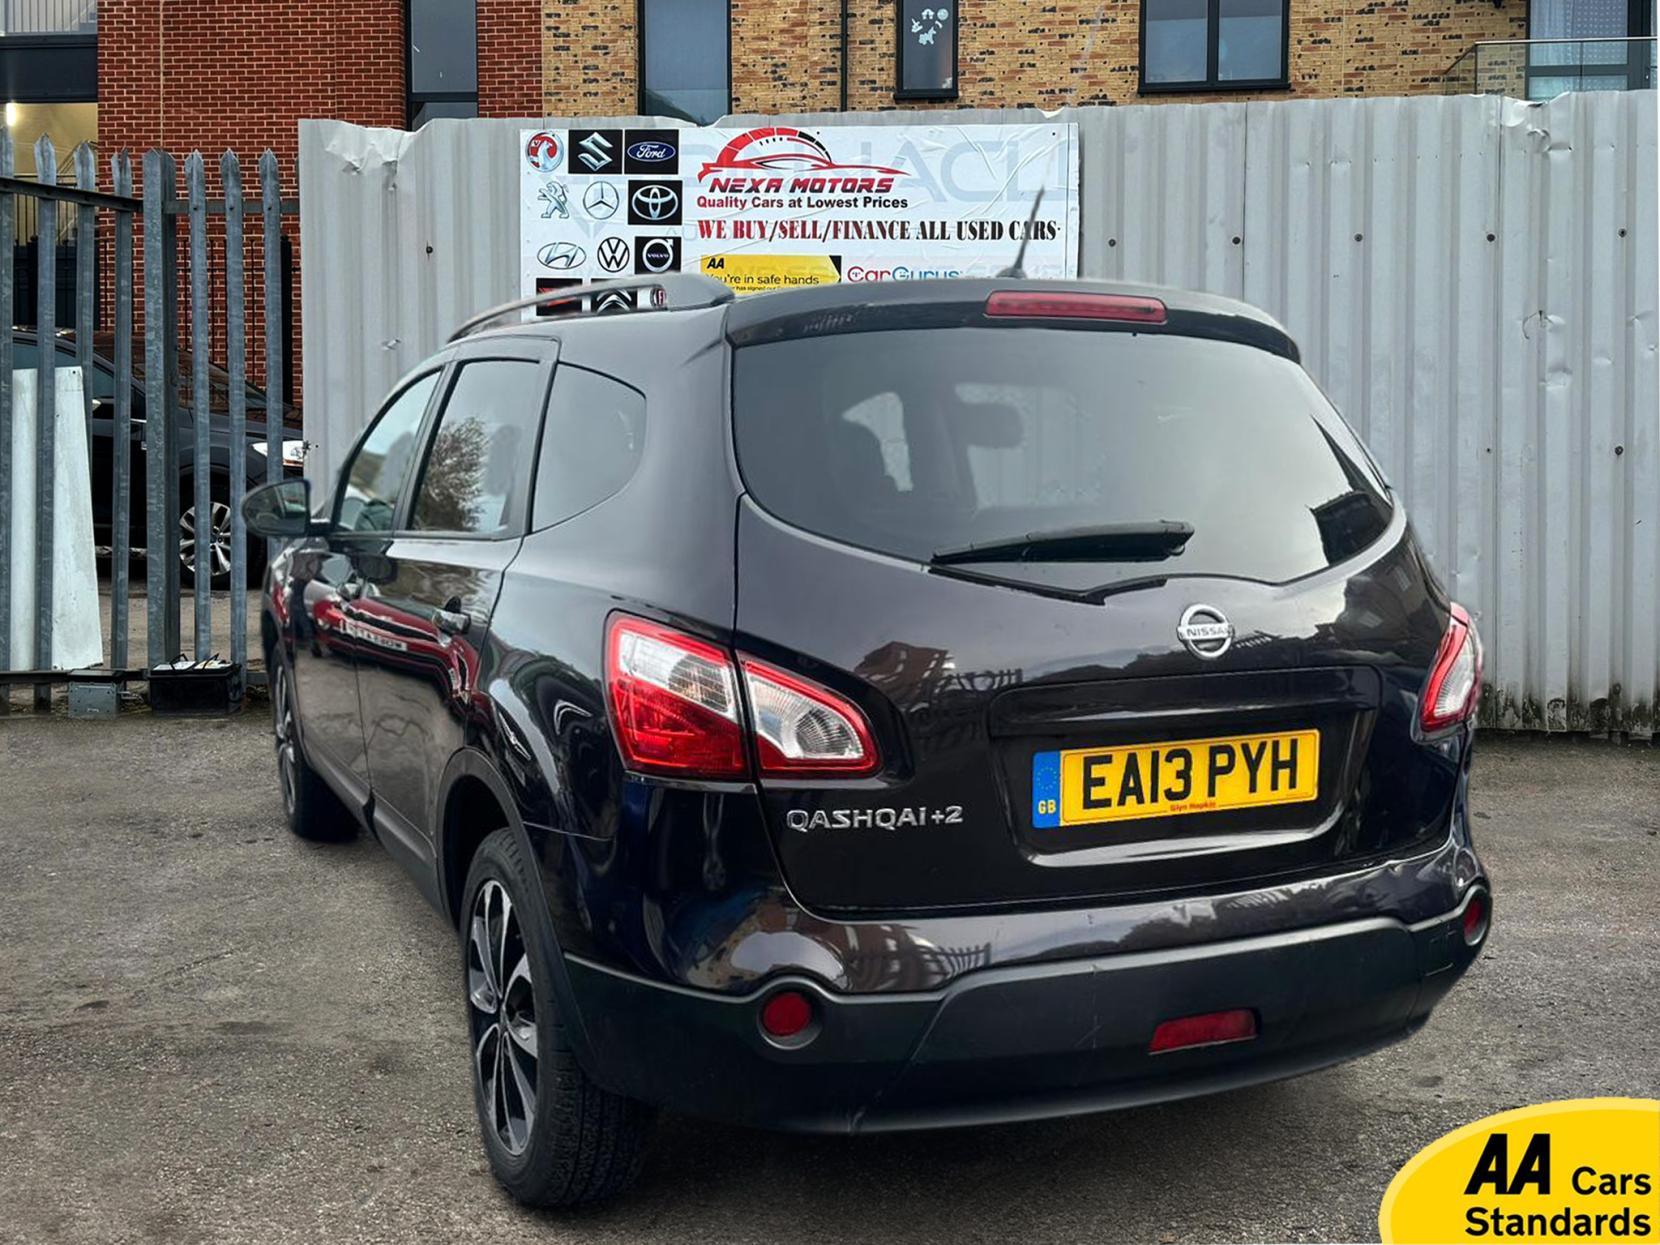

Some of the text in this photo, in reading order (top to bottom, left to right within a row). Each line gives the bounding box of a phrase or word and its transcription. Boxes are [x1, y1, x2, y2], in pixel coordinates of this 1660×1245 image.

[636, 144, 666, 159] Ford
[709, 178, 894, 193] NEXA MOTORS
[697, 196, 908, 210] Quality Cars at Lowest Prices
[698, 220, 726, 239] WE
[733, 219, 910, 242] BUY/SELL/FINANCE
[916, 220, 950, 240] ALL
[957, 220, 1003, 240] USED
[707, 258, 725, 269] AA
[744, 274, 754, 284] in
[757, 274, 781, 284] safe
[784, 275, 819, 284] hands
[1082, 738, 1298, 810] EA13 PYH
[1038, 800, 1056, 814] GB
